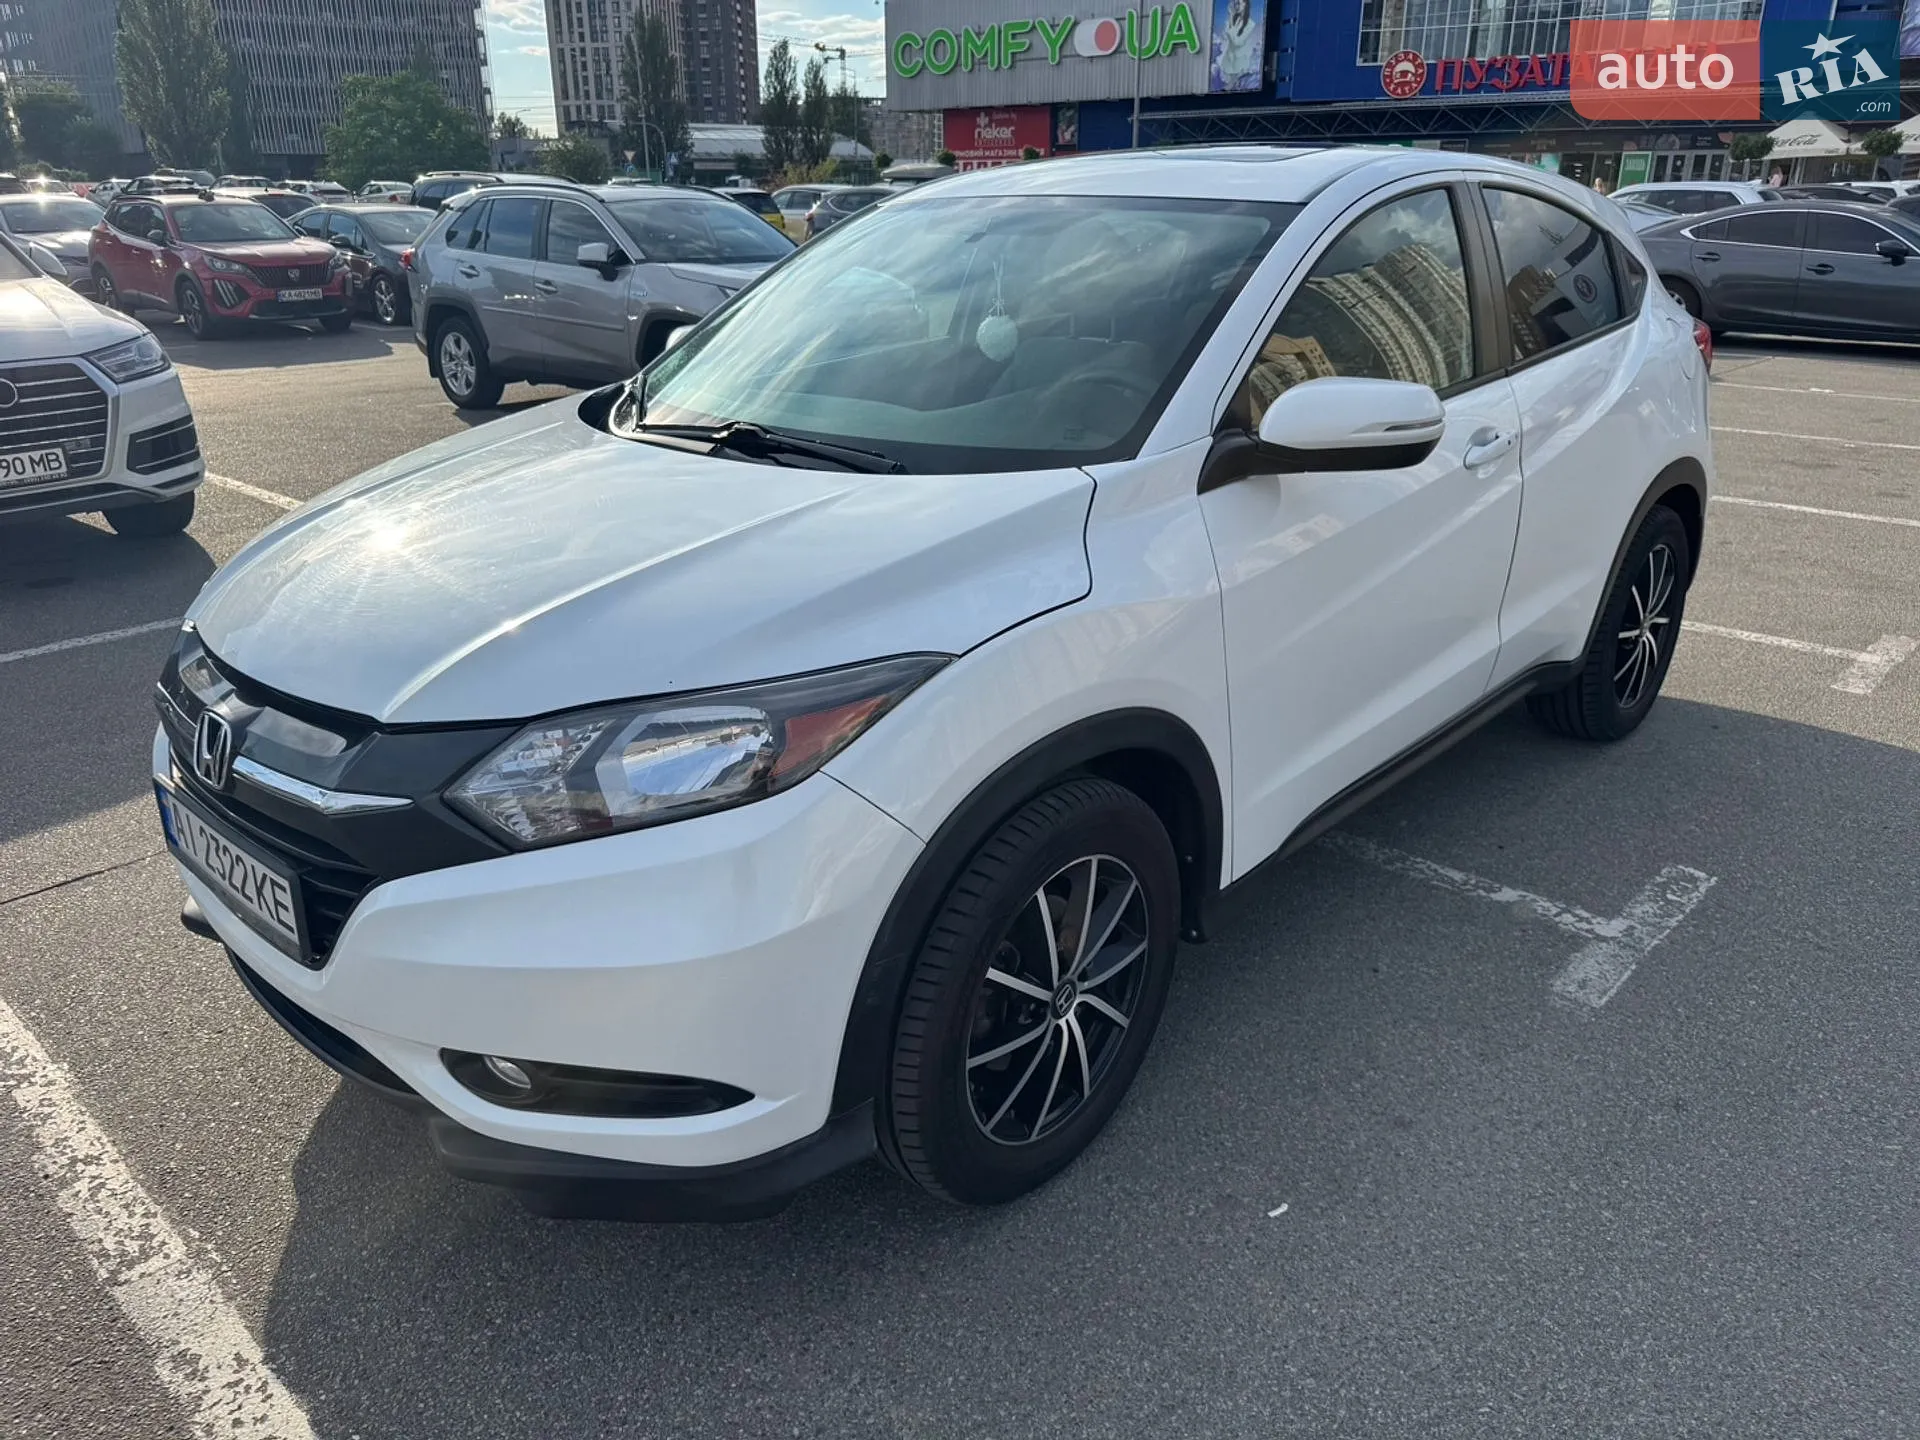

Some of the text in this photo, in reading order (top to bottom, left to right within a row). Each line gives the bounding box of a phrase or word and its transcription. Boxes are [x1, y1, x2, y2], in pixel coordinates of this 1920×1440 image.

[892, 1, 1200, 78] COMFY UA
[28, 452, 63, 473] MB
[172, 803, 295, 934] AI 2322 KE
